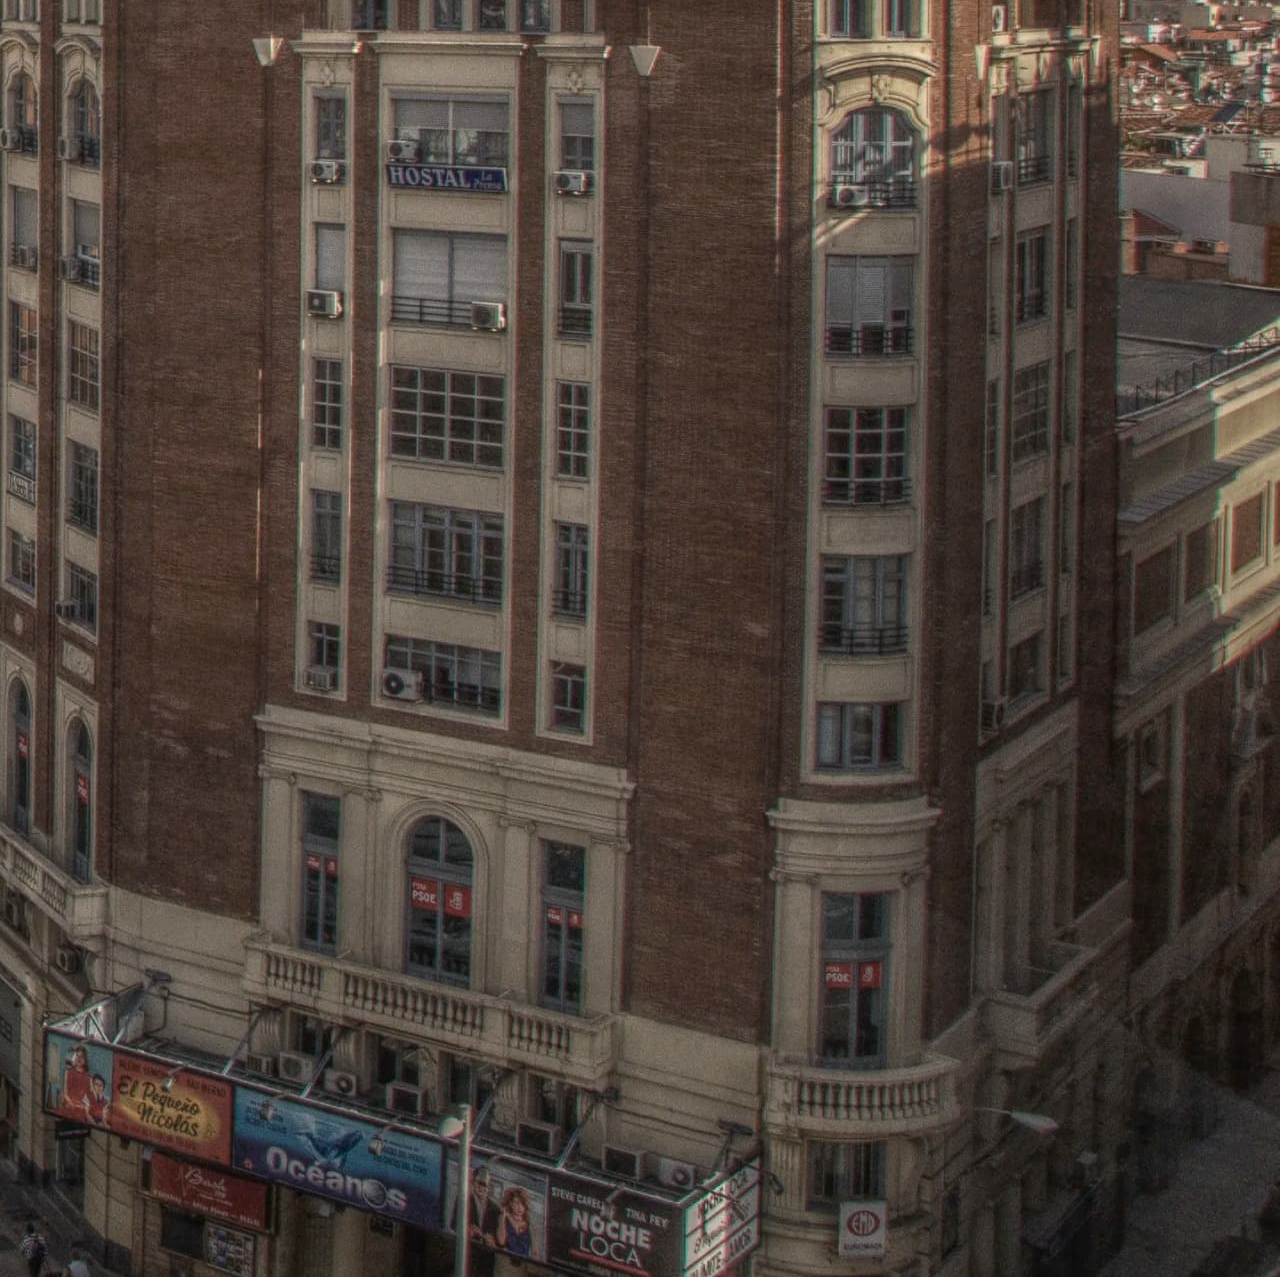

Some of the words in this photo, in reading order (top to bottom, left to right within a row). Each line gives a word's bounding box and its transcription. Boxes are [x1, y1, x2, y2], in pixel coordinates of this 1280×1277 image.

[389, 166, 471, 188] HOSTAL
[412, 889, 436, 904] PSOE
[825, 973, 850, 983] PSOE
[118, 1075, 140, 1098] El
[142, 1081, 201, 1116] Pequeño
[137, 1101, 200, 1138] Nicolás
[551, 1186, 576, 1202] STEVE
[625, 1207, 647, 1223] TINA
[649, 1214, 670, 1228] FEY
[571, 1207, 653, 1250] NOCHE
[579, 1231, 642, 1269] LOCA
